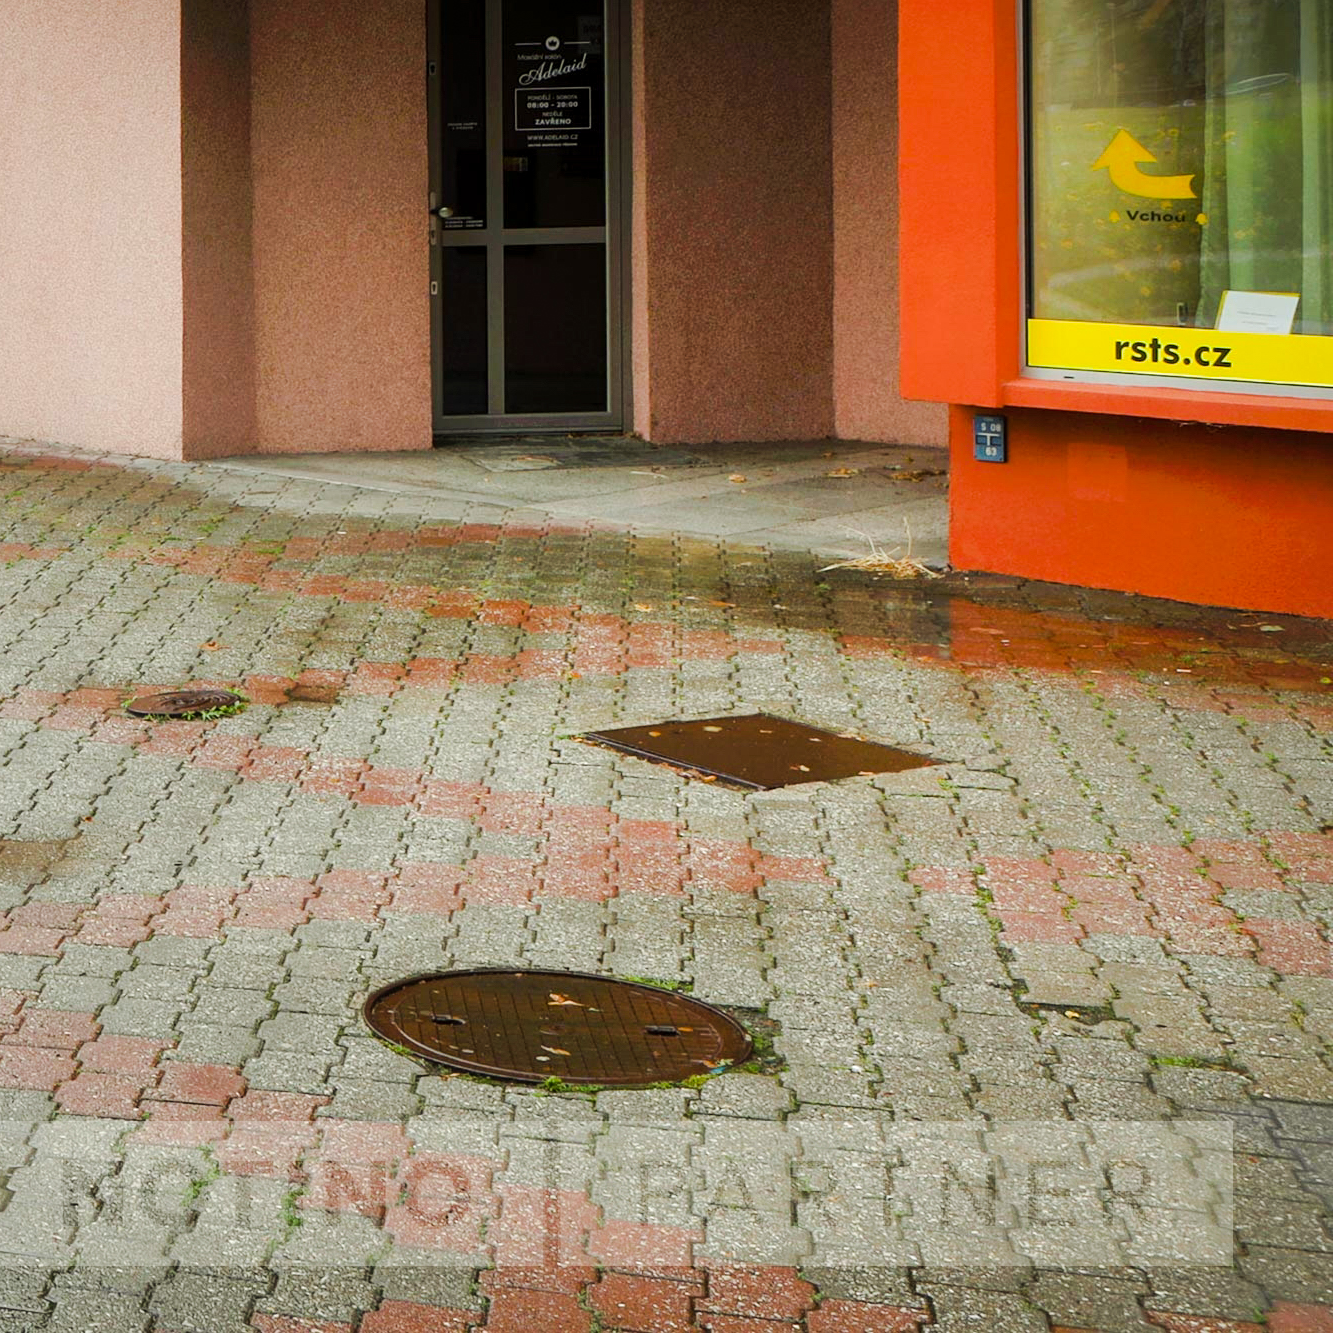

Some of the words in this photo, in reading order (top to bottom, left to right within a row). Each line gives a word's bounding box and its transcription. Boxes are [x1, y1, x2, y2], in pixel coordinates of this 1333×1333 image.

[518, 52, 588, 86] Adelaid
[534, 117, 572, 126] ZAVŘENO
[1115, 338, 1232, 368] rsts.cz
